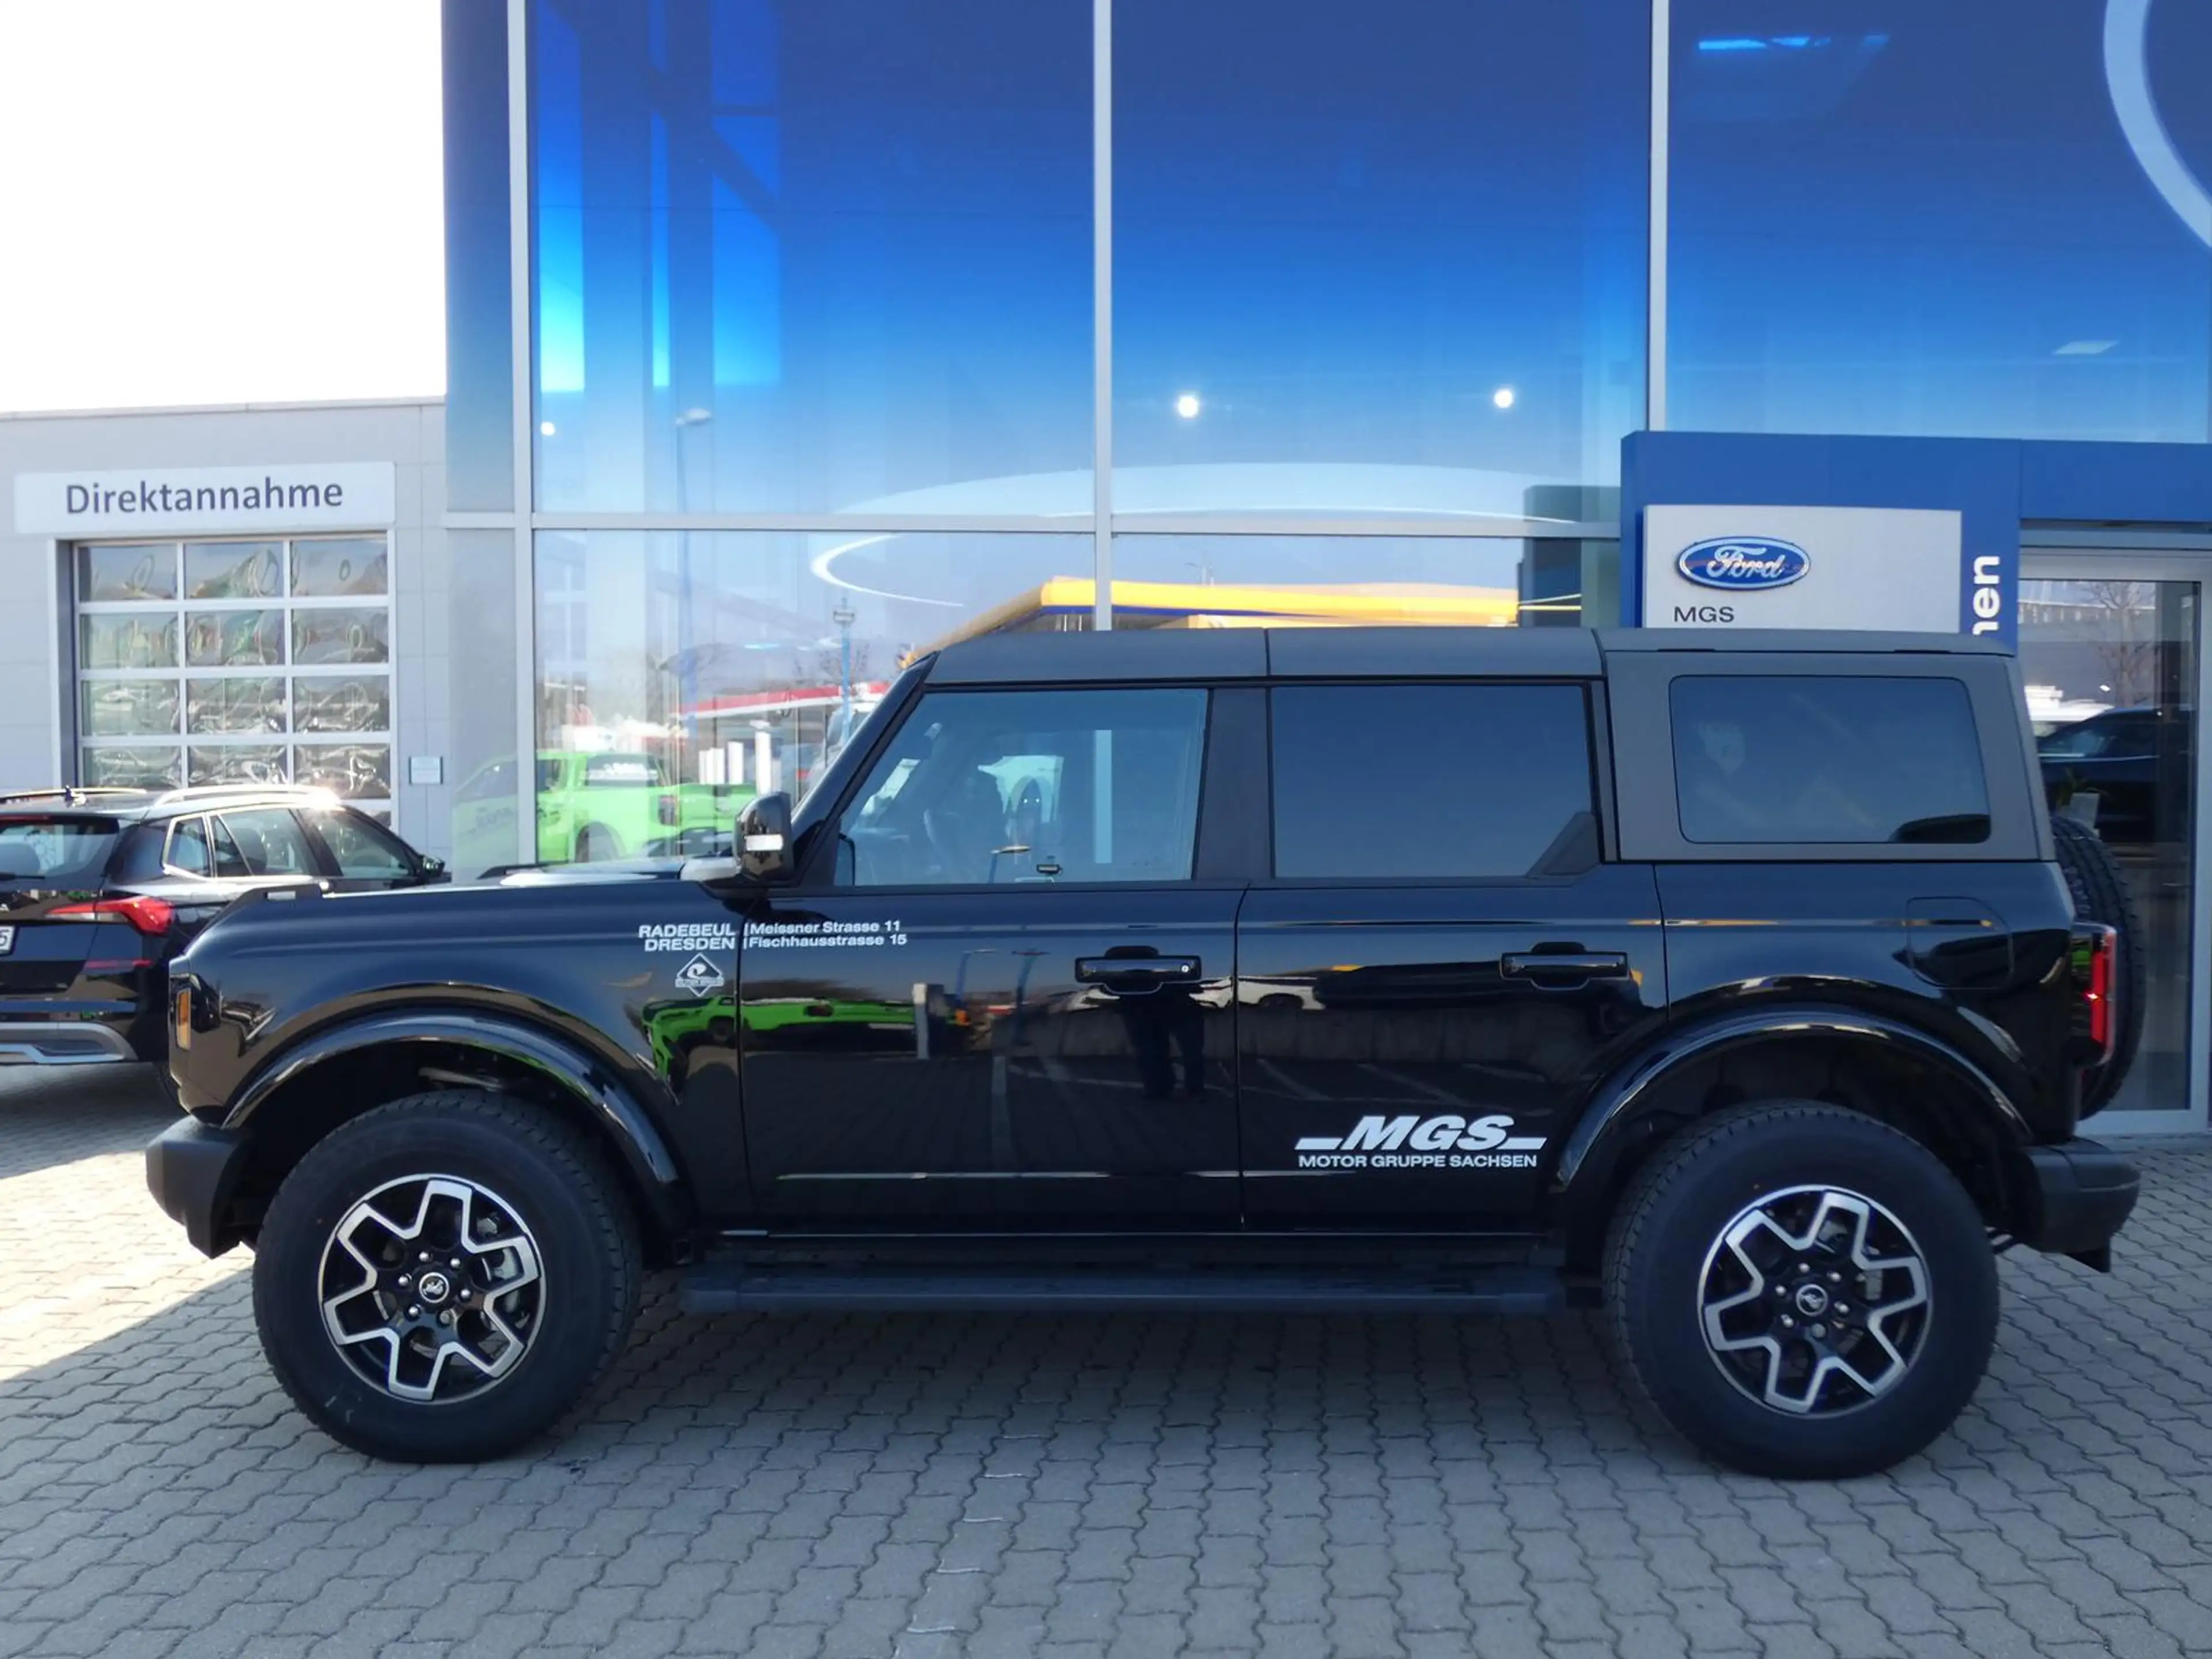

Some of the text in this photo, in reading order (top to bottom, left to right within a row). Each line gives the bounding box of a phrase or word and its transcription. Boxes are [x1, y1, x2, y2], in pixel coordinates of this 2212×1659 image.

[66, 476, 343, 514] Direktannahme
[1706, 546, 1786, 578] Ford
[1674, 606, 1734, 623] MGS
[638, 920, 900, 938] RADEBEUL Meissner Strasse 11
[644, 934, 908, 952] DRESDEN Fischhausstrasse 15
[1340, 1115, 1514, 1151] MGS
[1298, 1154, 1537, 1168] MOTOR GRUPPE SACHSEN
